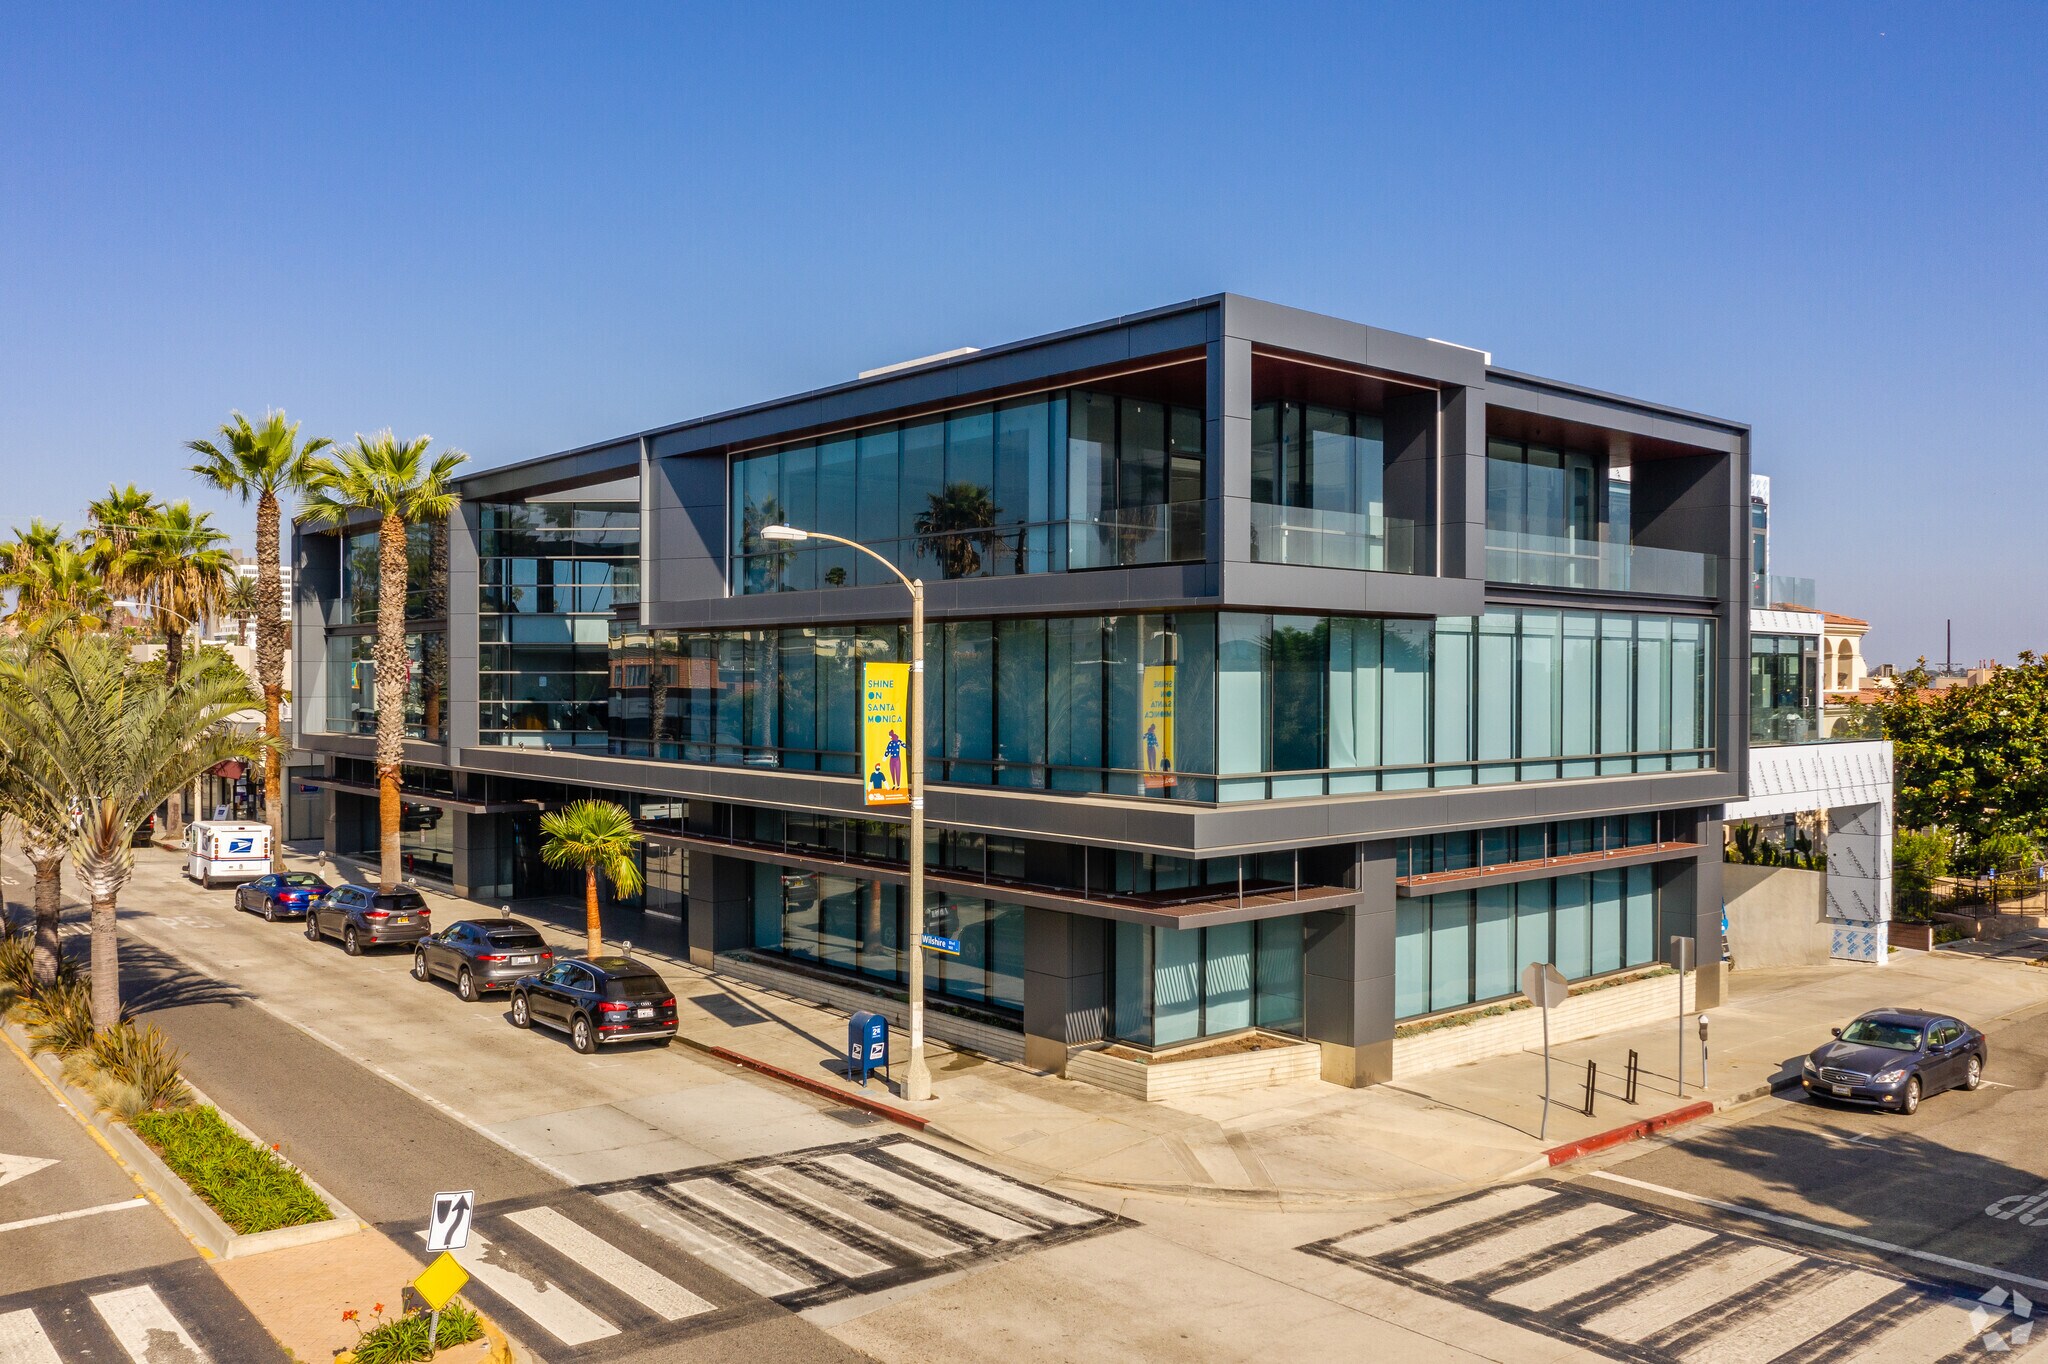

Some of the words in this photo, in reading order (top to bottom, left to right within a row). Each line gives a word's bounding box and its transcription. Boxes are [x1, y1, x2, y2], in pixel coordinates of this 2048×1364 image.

[868, 680, 894, 688] SHINE
[868, 692, 882, 700] ON
[868, 704, 894, 712] SANTA
[868, 715, 902, 723] MONICA
[922, 934, 946, 947] Wilshire
